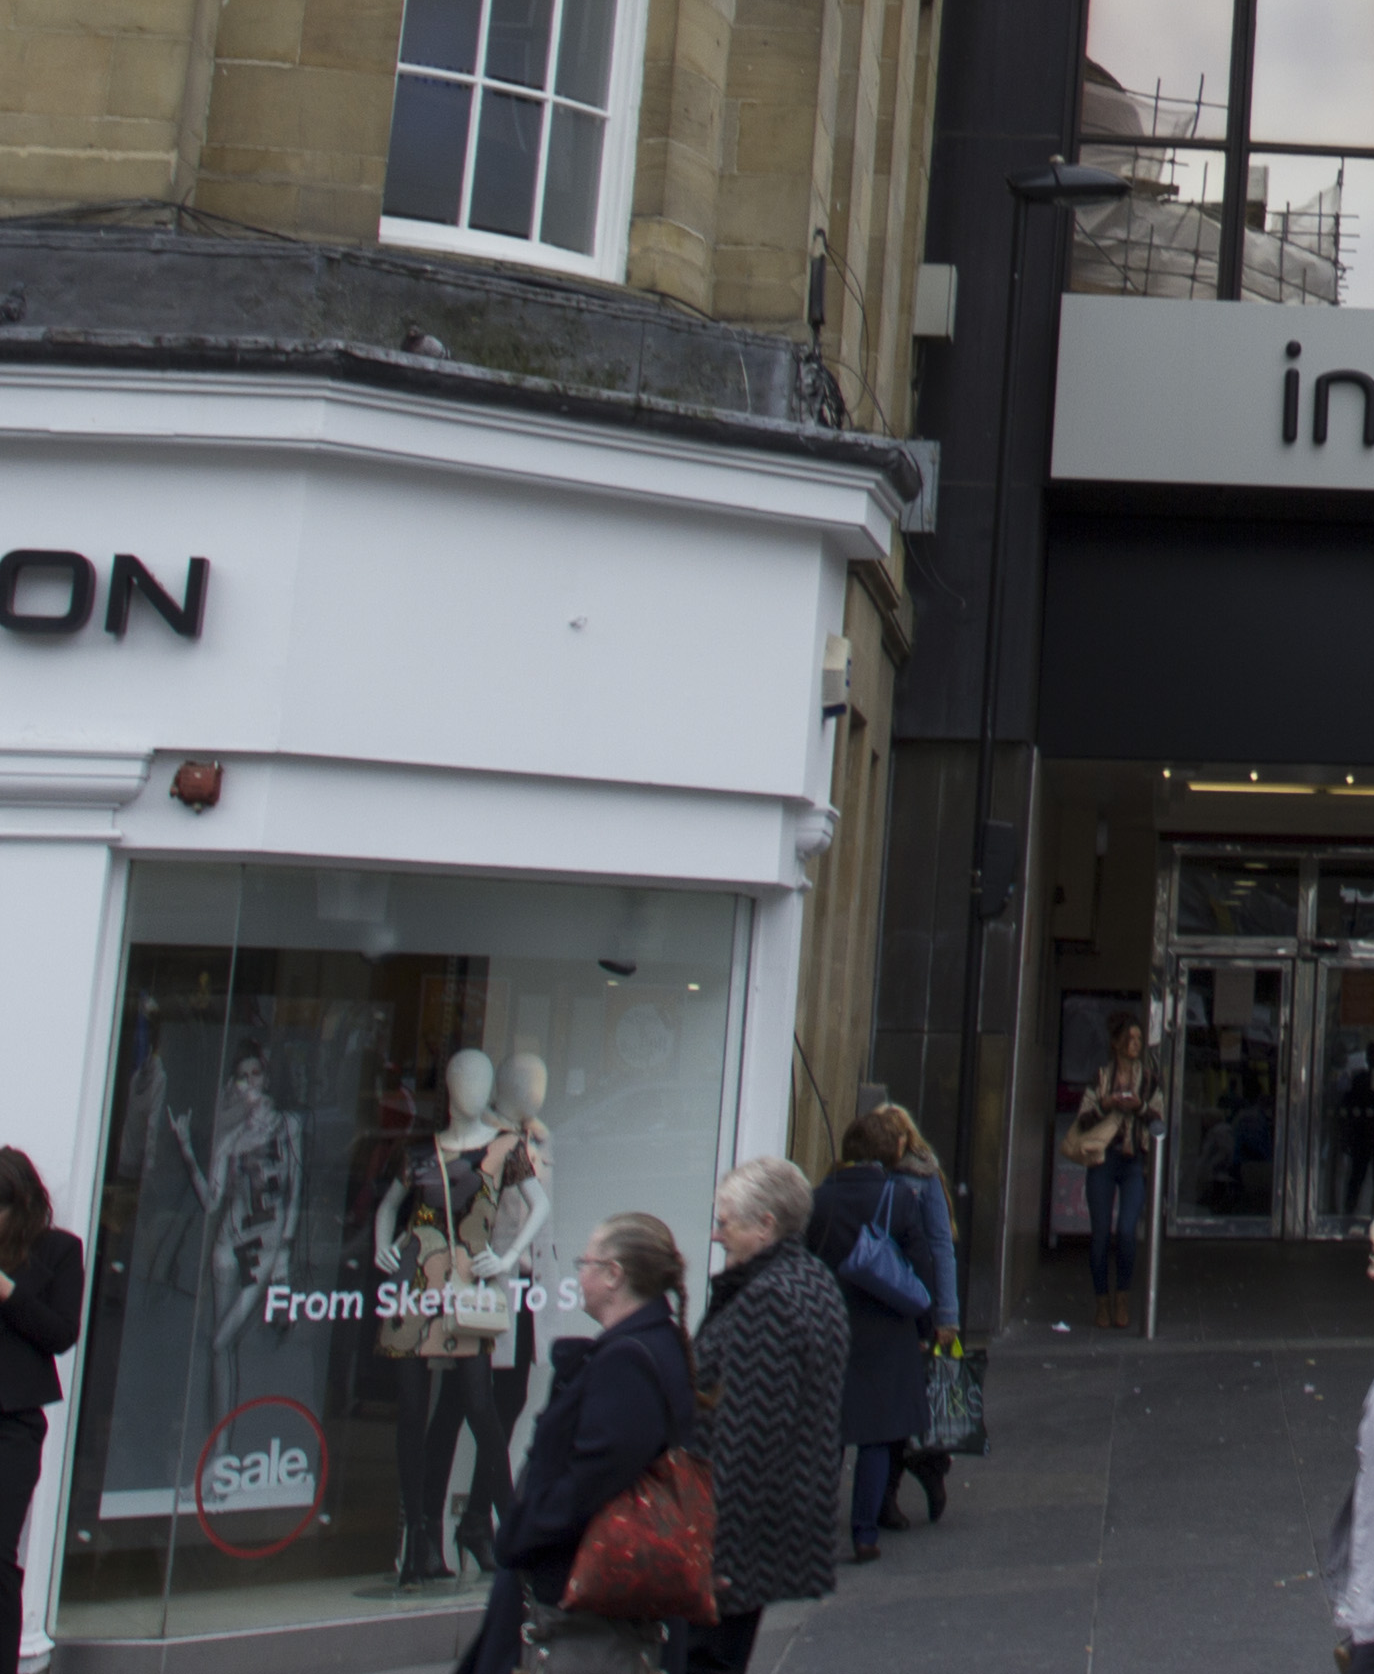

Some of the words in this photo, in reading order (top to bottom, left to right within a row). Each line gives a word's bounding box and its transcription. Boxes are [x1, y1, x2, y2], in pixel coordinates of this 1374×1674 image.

[264, 1285, 363, 1323] From
[376, 1279, 497, 1318] Sketch
[508, 1278, 548, 1312] To
